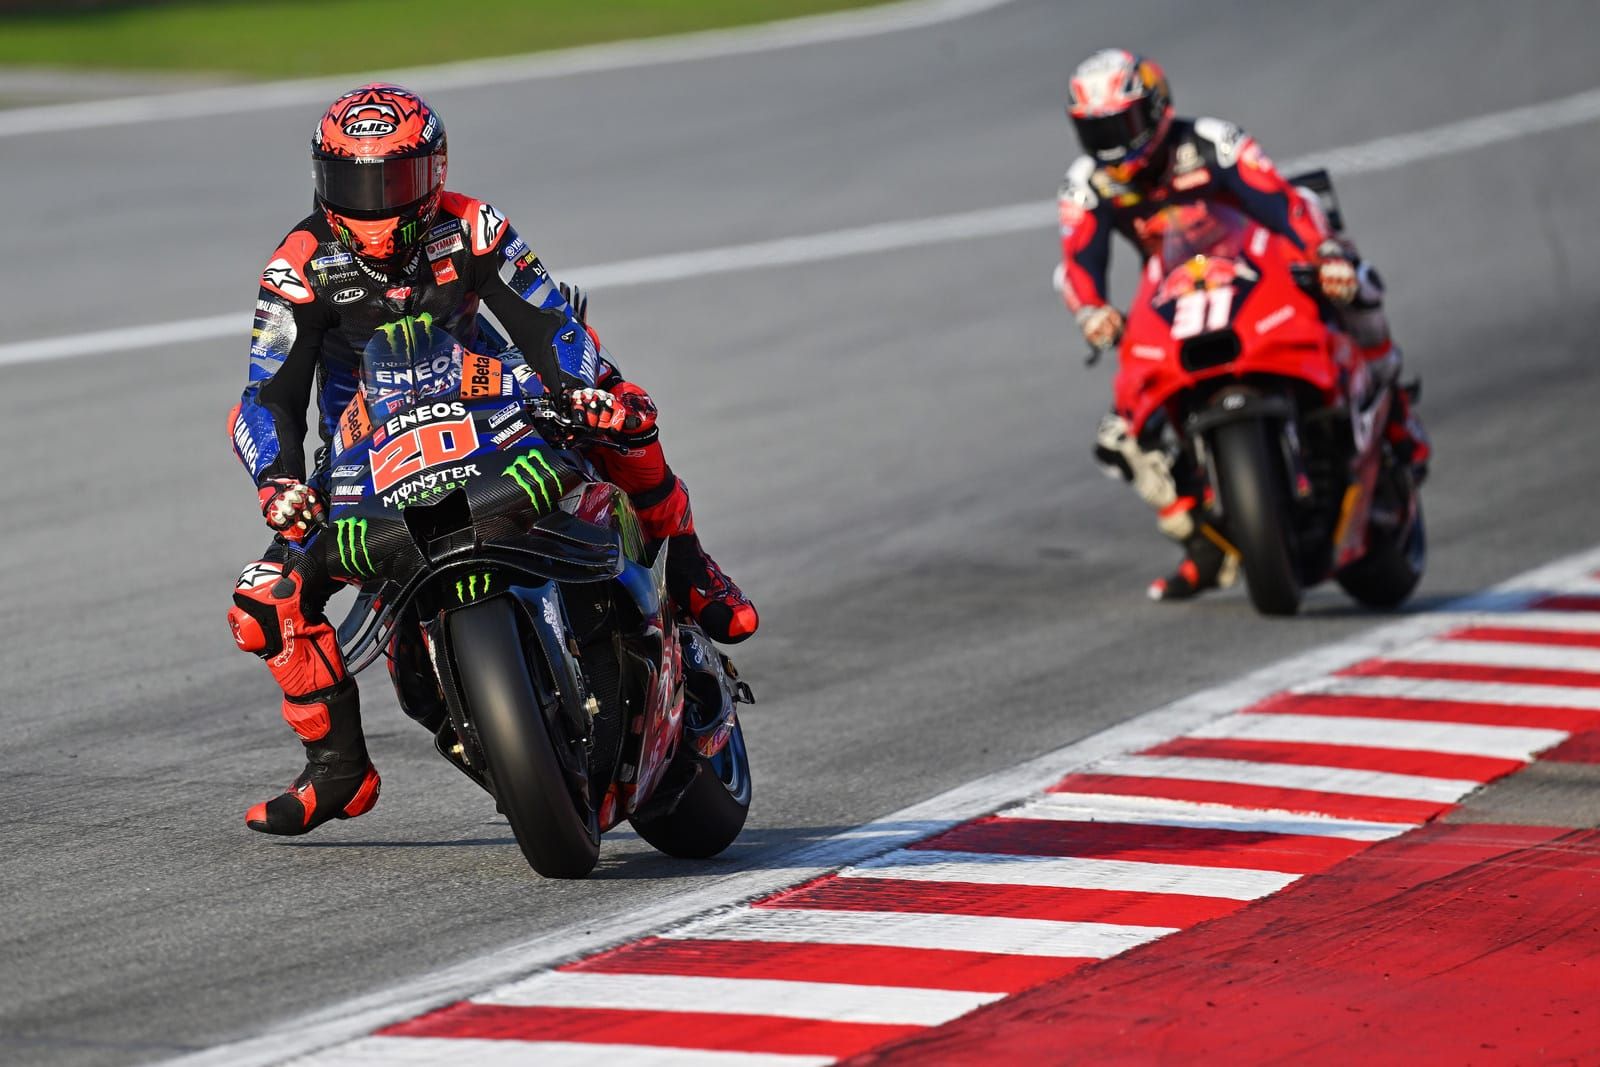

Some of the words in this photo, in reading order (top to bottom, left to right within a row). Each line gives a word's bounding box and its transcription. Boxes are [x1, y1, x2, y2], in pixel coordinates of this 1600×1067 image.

[350, 123, 390, 133] HJC
[336, 290, 361, 301] HJC
[376, 355, 451, 385] ENEO
[473, 356, 490, 386] Beta
[346, 410, 362, 443] Beta
[386, 402, 466, 436] ENEOS
[490, 420, 527, 445] YAMALUBE
[368, 411, 480, 495] 20
[382, 463, 482, 508] MONSTER
[397, 479, 468, 511] ENERGY
